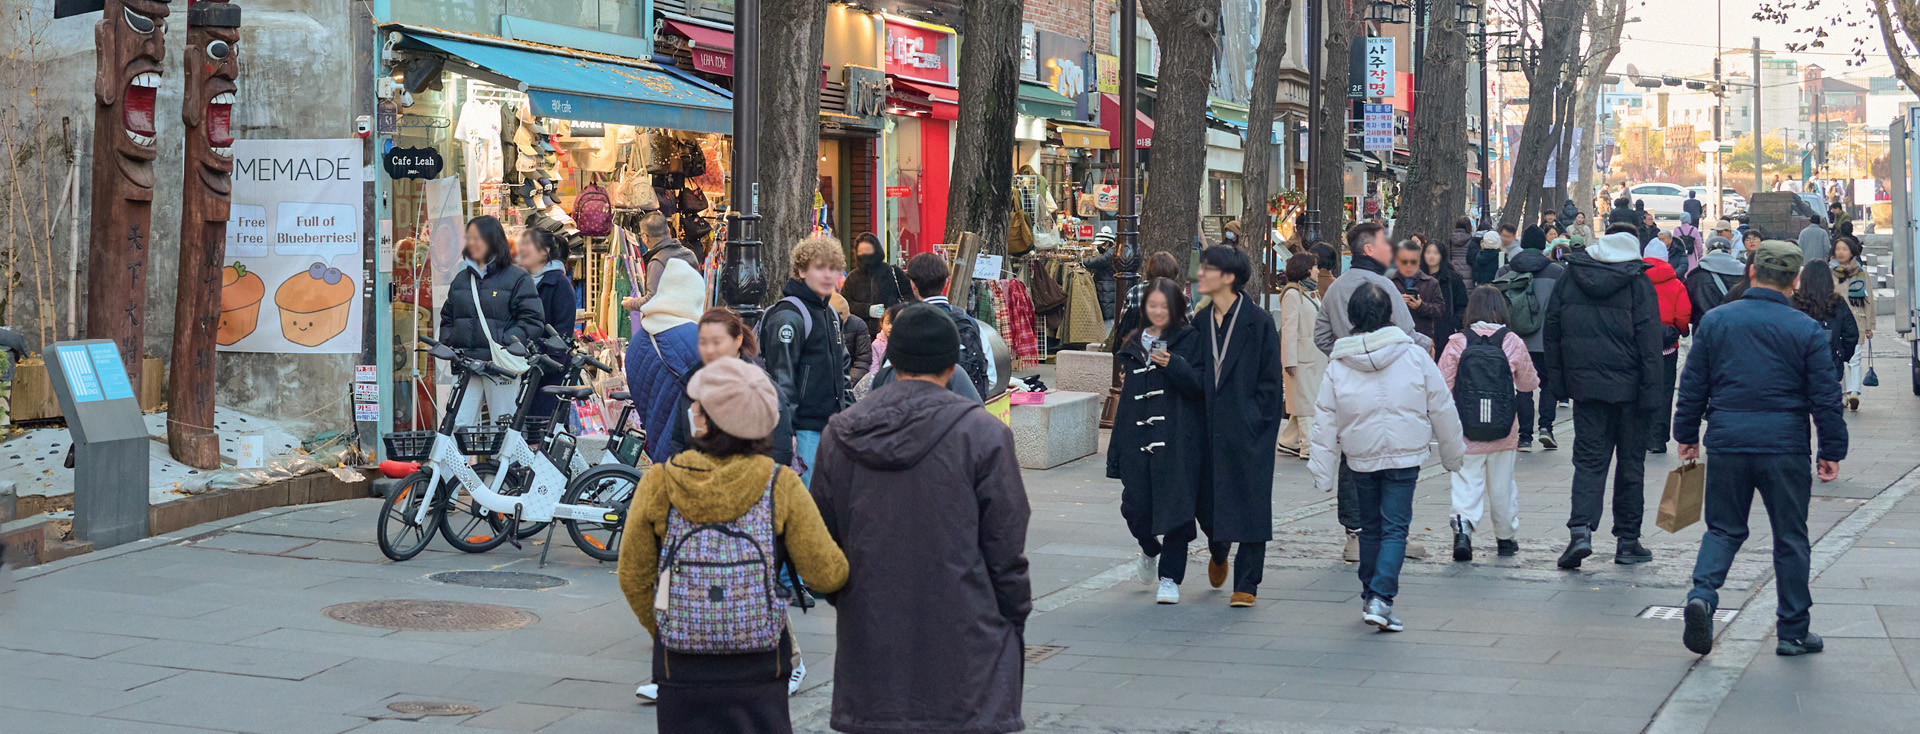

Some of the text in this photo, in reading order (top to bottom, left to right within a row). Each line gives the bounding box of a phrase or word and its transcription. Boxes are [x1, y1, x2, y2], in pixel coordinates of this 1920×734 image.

[392, 156, 434, 166] Cafe Leah
[238, 216, 266, 227] Free
[296, 216, 335, 226] Full of
[236, 232, 264, 243] Free
[277, 232, 356, 244] Blueberries!
